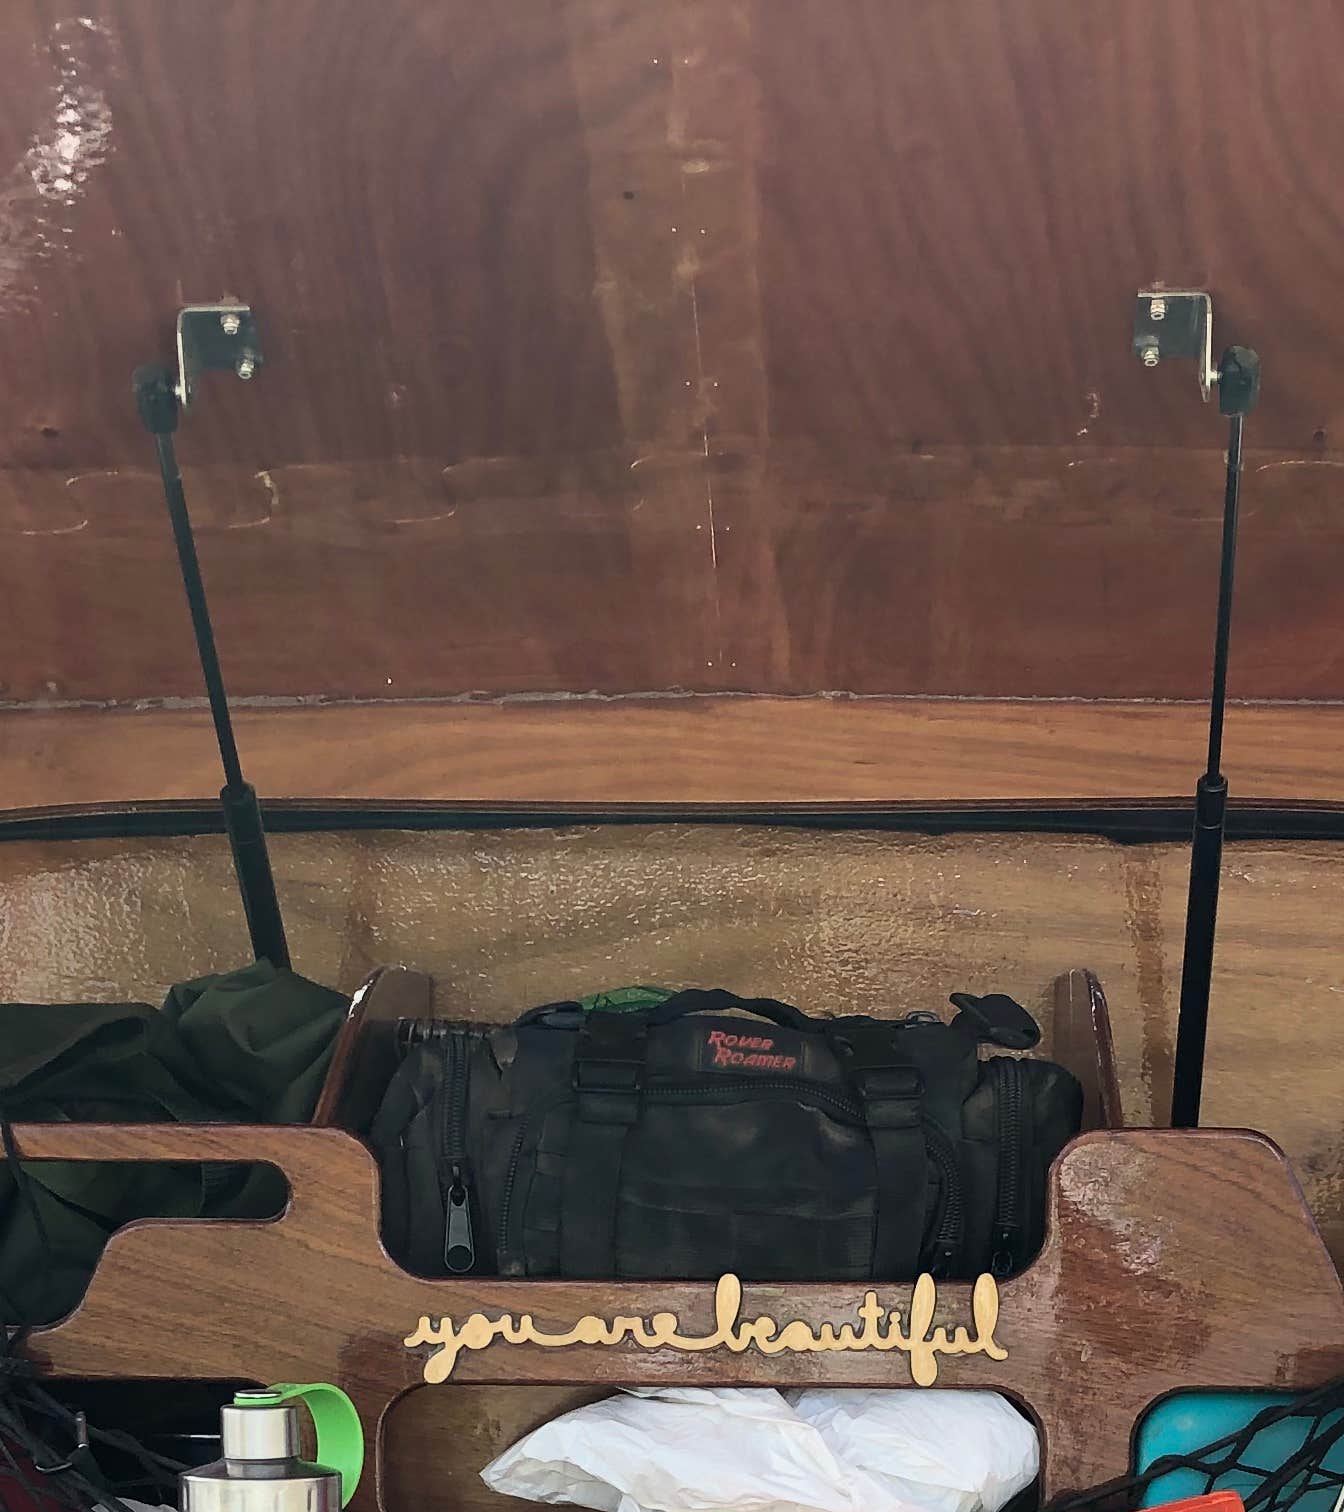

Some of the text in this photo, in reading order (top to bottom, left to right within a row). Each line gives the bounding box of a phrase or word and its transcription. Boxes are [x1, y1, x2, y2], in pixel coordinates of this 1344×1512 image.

[404, 1273, 1010, 1387] you are beautiful
